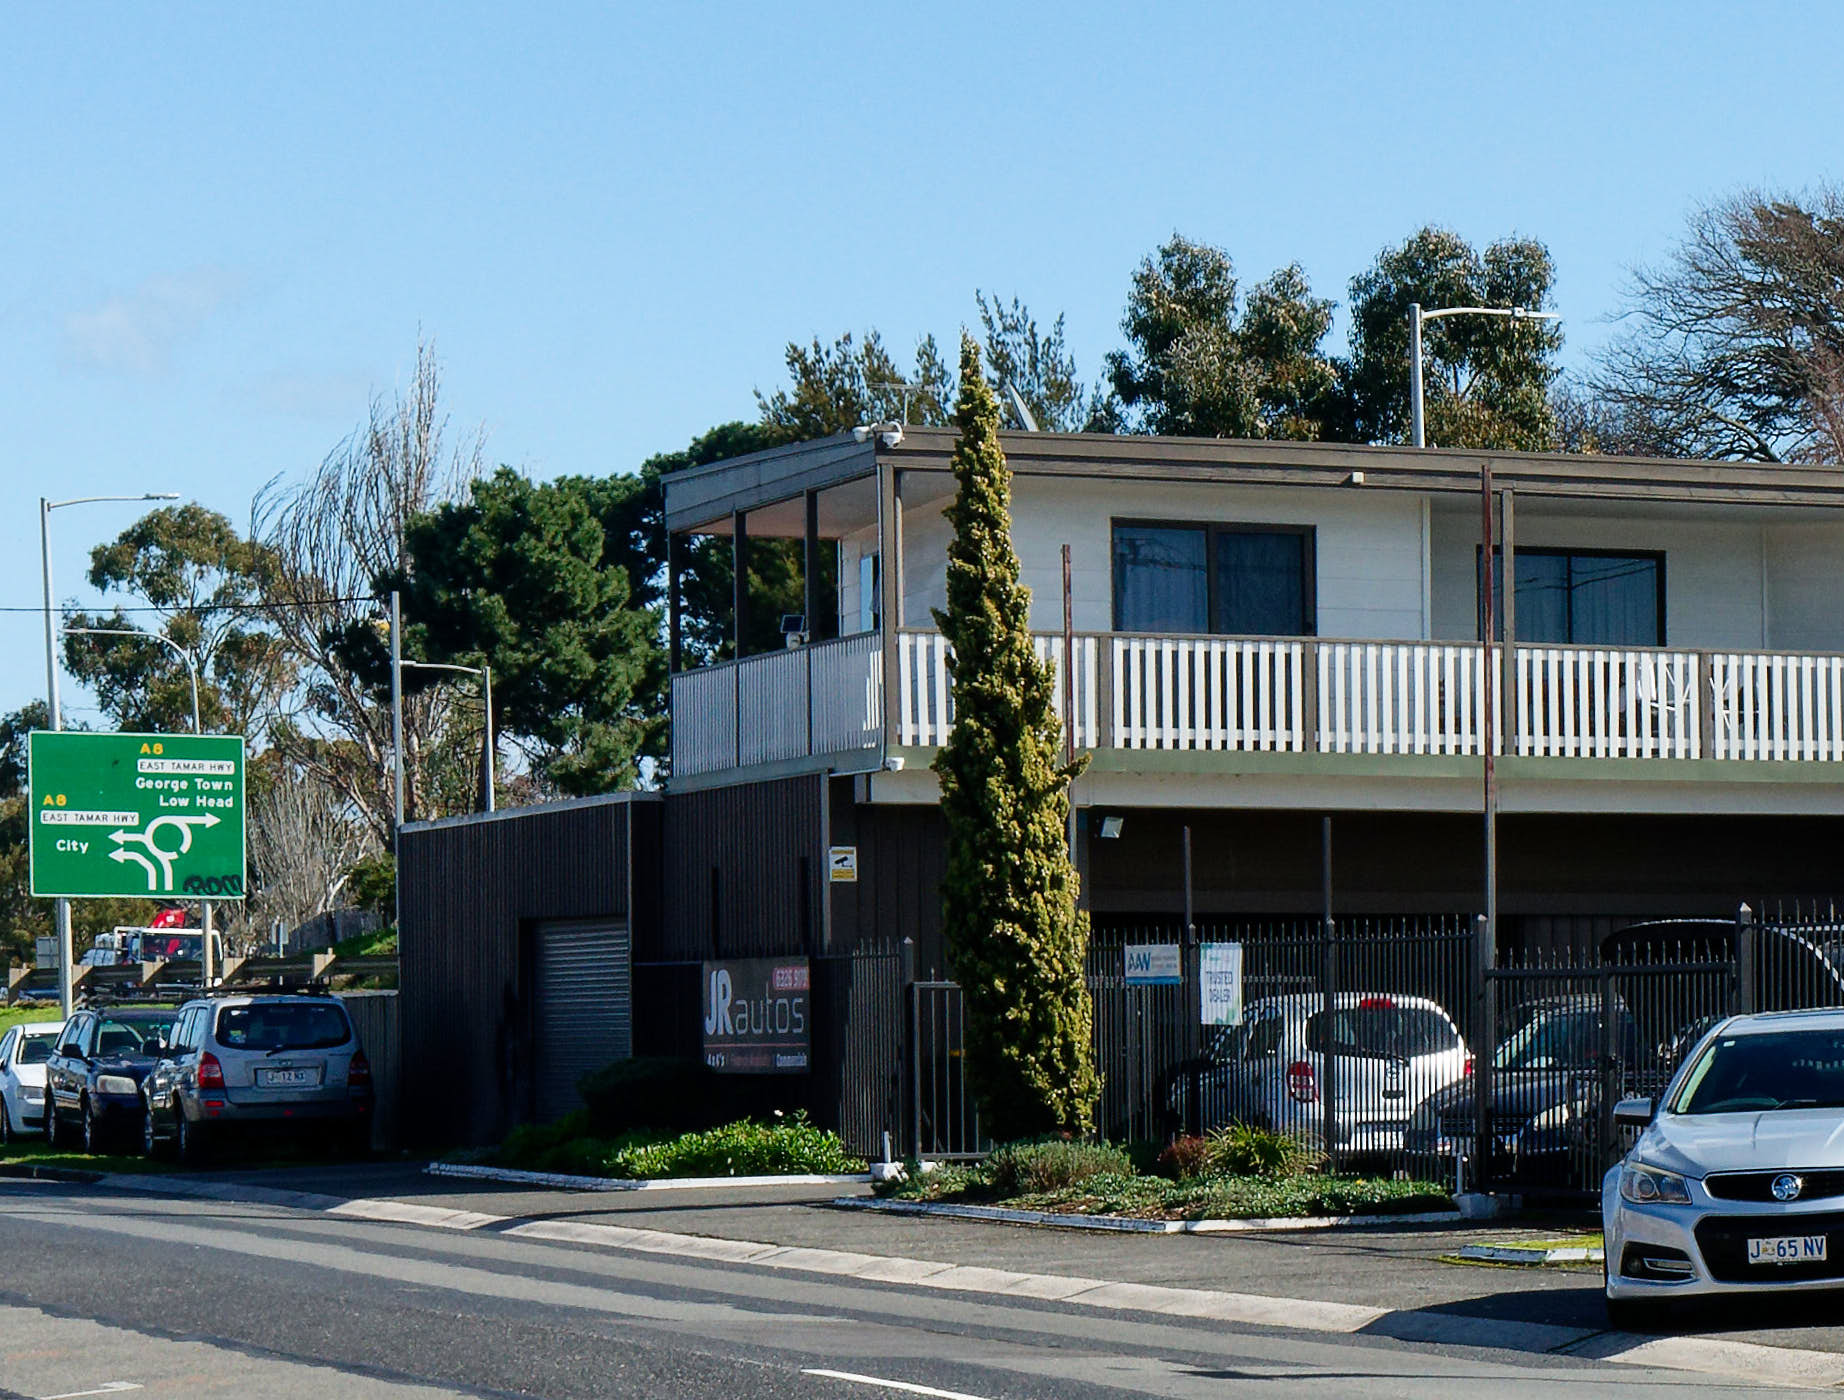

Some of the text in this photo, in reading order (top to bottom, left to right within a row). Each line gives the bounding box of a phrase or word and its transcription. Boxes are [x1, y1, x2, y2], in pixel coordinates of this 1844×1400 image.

[139, 743, 164, 755] A8
[139, 761, 233, 773] EAST TAMAR HWY
[135, 776, 234, 793] George Town
[42, 794, 67, 806] A8
[159, 794, 234, 808] Low Head
[42, 813, 137, 824] EAST TAMAR HWY
[55, 839, 89, 854] City
[1127, 951, 1151, 972] AAW
[704, 969, 805, 1036] JR autos
[1750, 1237, 1825, 1259] J 65 NV
